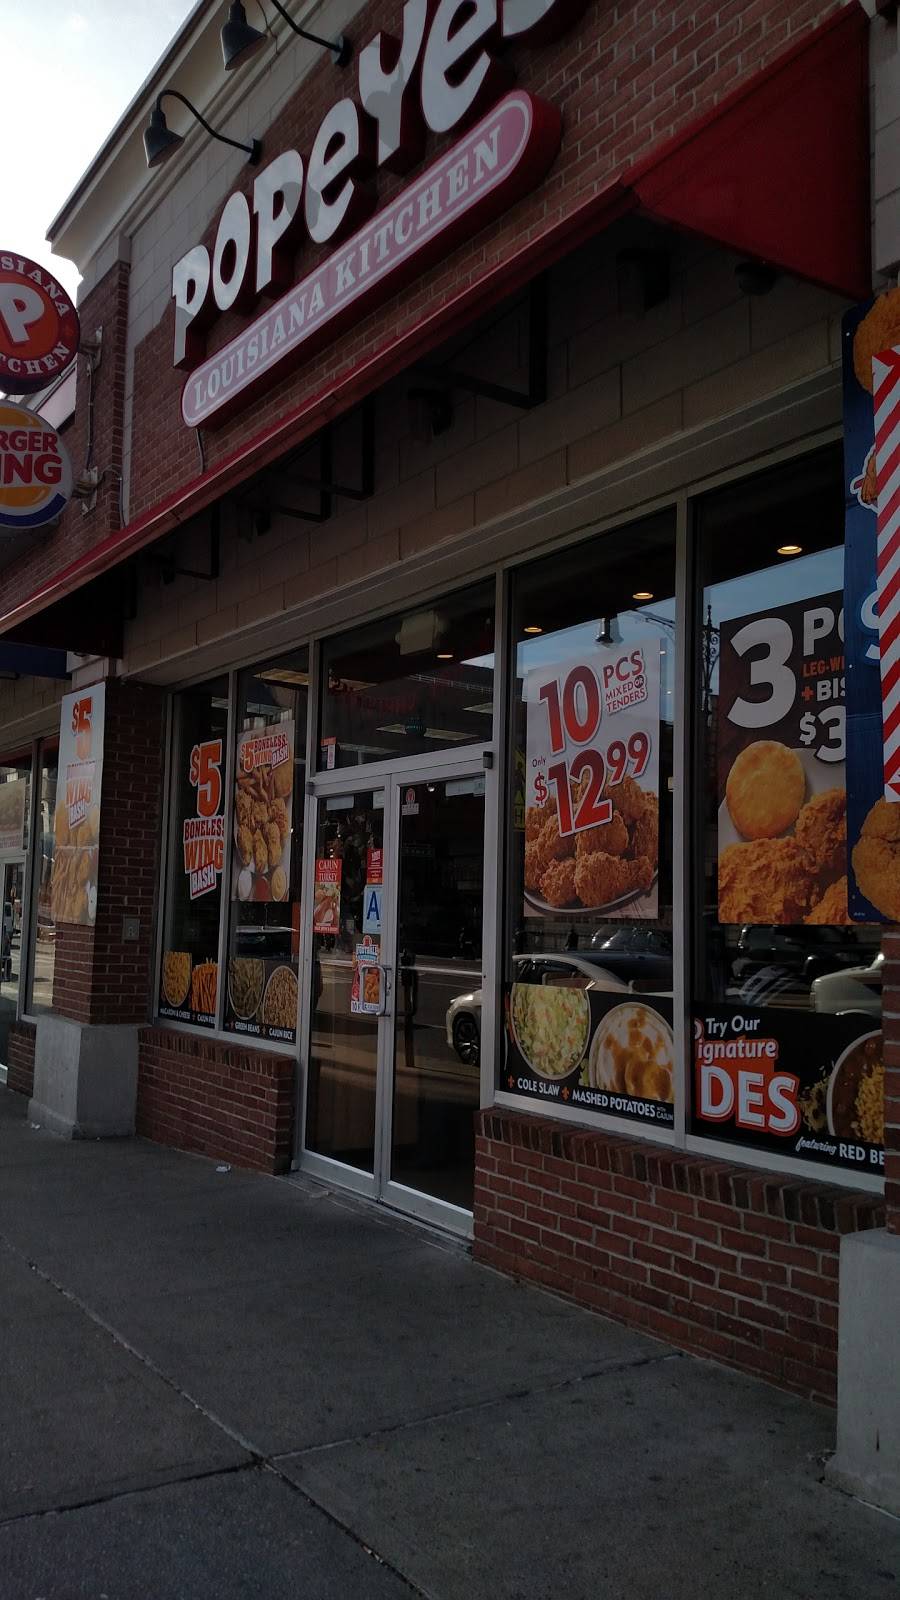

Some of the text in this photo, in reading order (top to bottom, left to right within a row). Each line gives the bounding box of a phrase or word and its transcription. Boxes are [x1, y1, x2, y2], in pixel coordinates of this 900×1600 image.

[193, 127, 502, 411] LOUISIANA KITCHEN
[727, 617, 797, 729] 3
[539, 650, 644, 751] 10 PCS
[605, 681, 634, 702] MIXED
[606, 688, 646, 713] TENDERS
[254, 733, 287, 752] BONELESS
[272, 746, 289, 767] BASH
[532, 756, 547, 768] Only
[190, 740, 222, 818] $5
[185, 817, 225, 840] BONELES
[318, 860, 338, 871] CAJUN
[318, 872, 338, 882] TURKEY
[191, 864, 215, 896] BASH
[366, 890, 380, 920] A
[706, 1015, 761, 1038] Try Our
[517, 1077, 538, 1092] COLE
[538, 1081, 560, 1096] SLAW
[572, 1089, 608, 1107] MASHED
[609, 1095, 656, 1118] POTATOES
[700, 1064, 799, 1132] DES
[795, 1136, 837, 1156] featuring
[839, 1143, 866, 1162] RED
